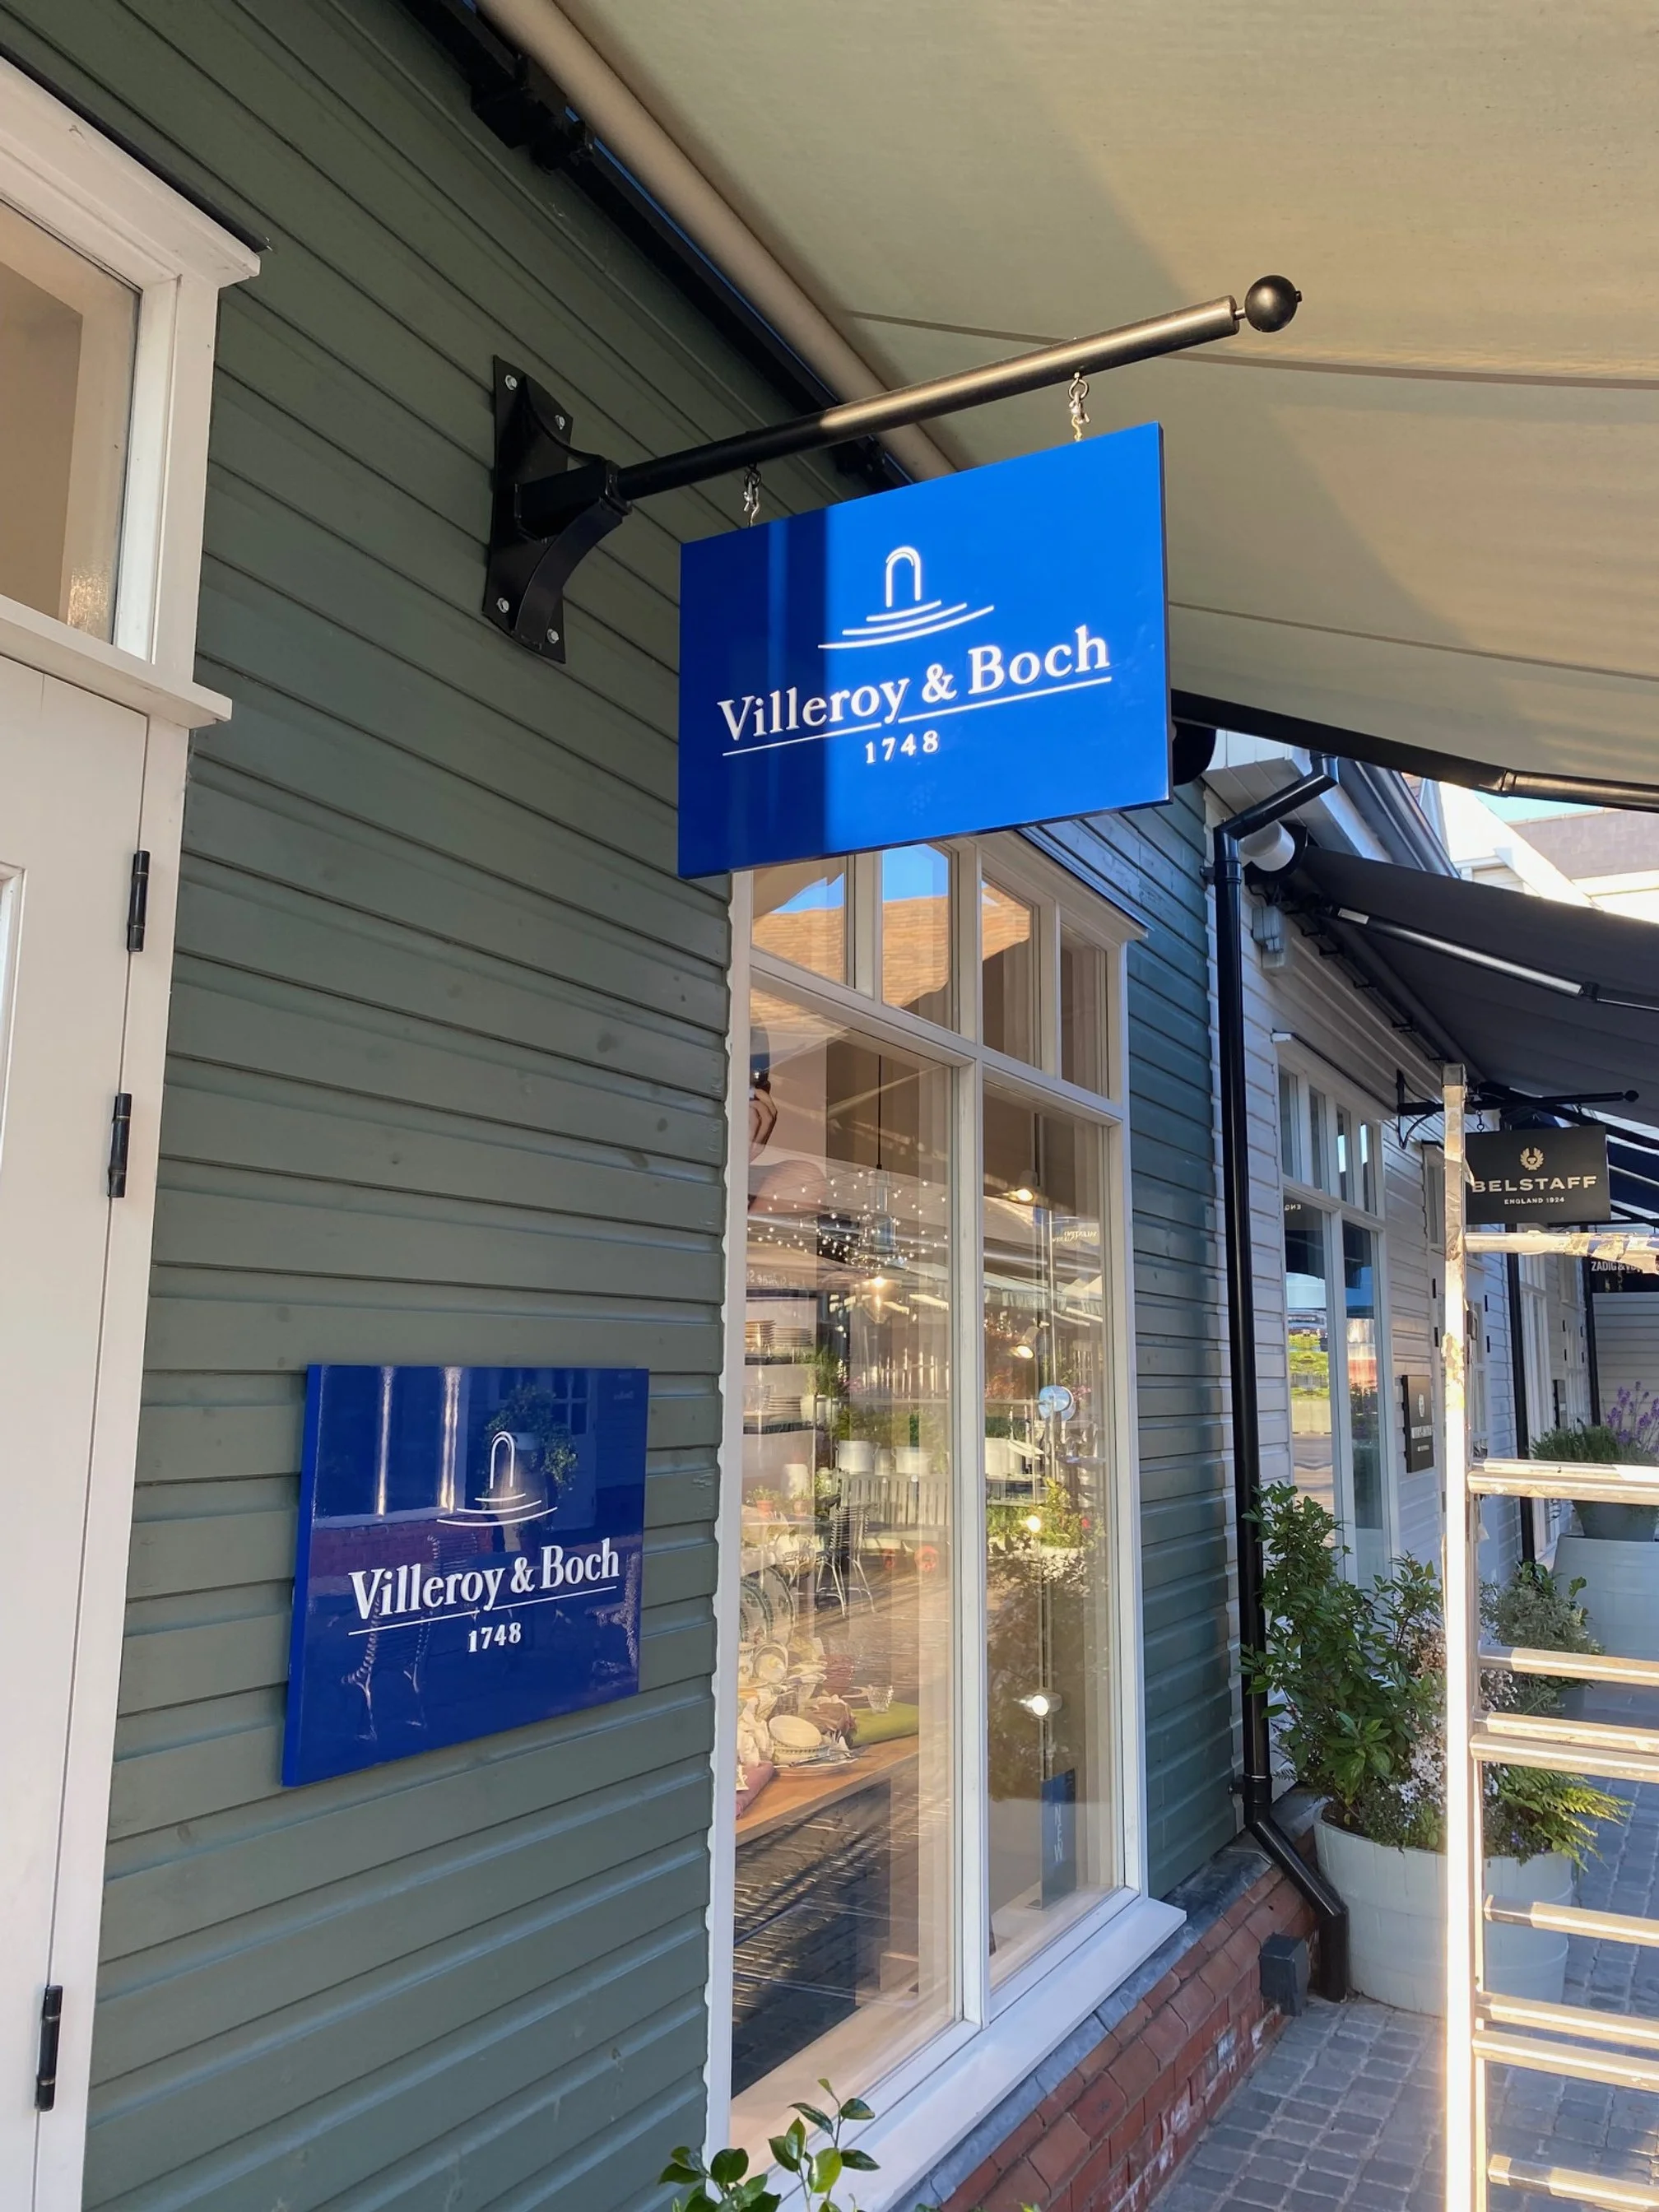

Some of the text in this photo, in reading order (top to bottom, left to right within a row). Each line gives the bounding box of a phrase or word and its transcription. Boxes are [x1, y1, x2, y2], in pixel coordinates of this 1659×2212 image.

[718, 624, 1111, 741] Villeroy & Boch
[866, 730, 939, 764] 1748
[1472, 1176, 1597, 1192] BELSTAFF
[348, 1537, 620, 1620] Villeroy & Boch
[468, 1622, 522, 1652] 1748
